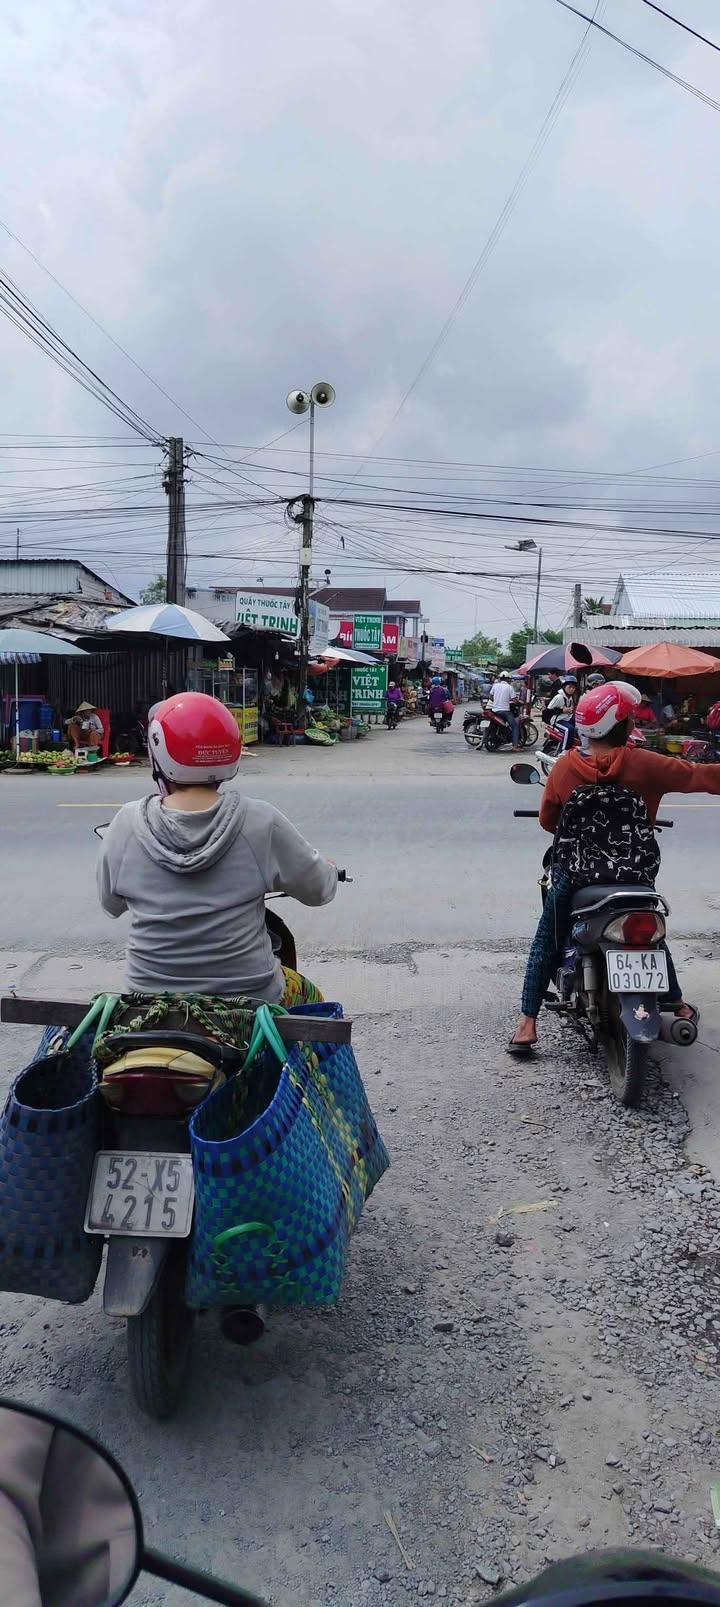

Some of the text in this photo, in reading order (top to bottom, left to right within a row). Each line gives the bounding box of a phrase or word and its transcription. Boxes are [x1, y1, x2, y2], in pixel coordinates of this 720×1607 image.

[279, 600, 291, 610] TÂY
[352, 673, 380, 689] VIỆT
[616, 953, 658, 970] 64-KA
[612, 972, 665, 989] 030.72
[106, 1157, 182, 1192] 52-X5
[101, 1194, 178, 1230] 4215
